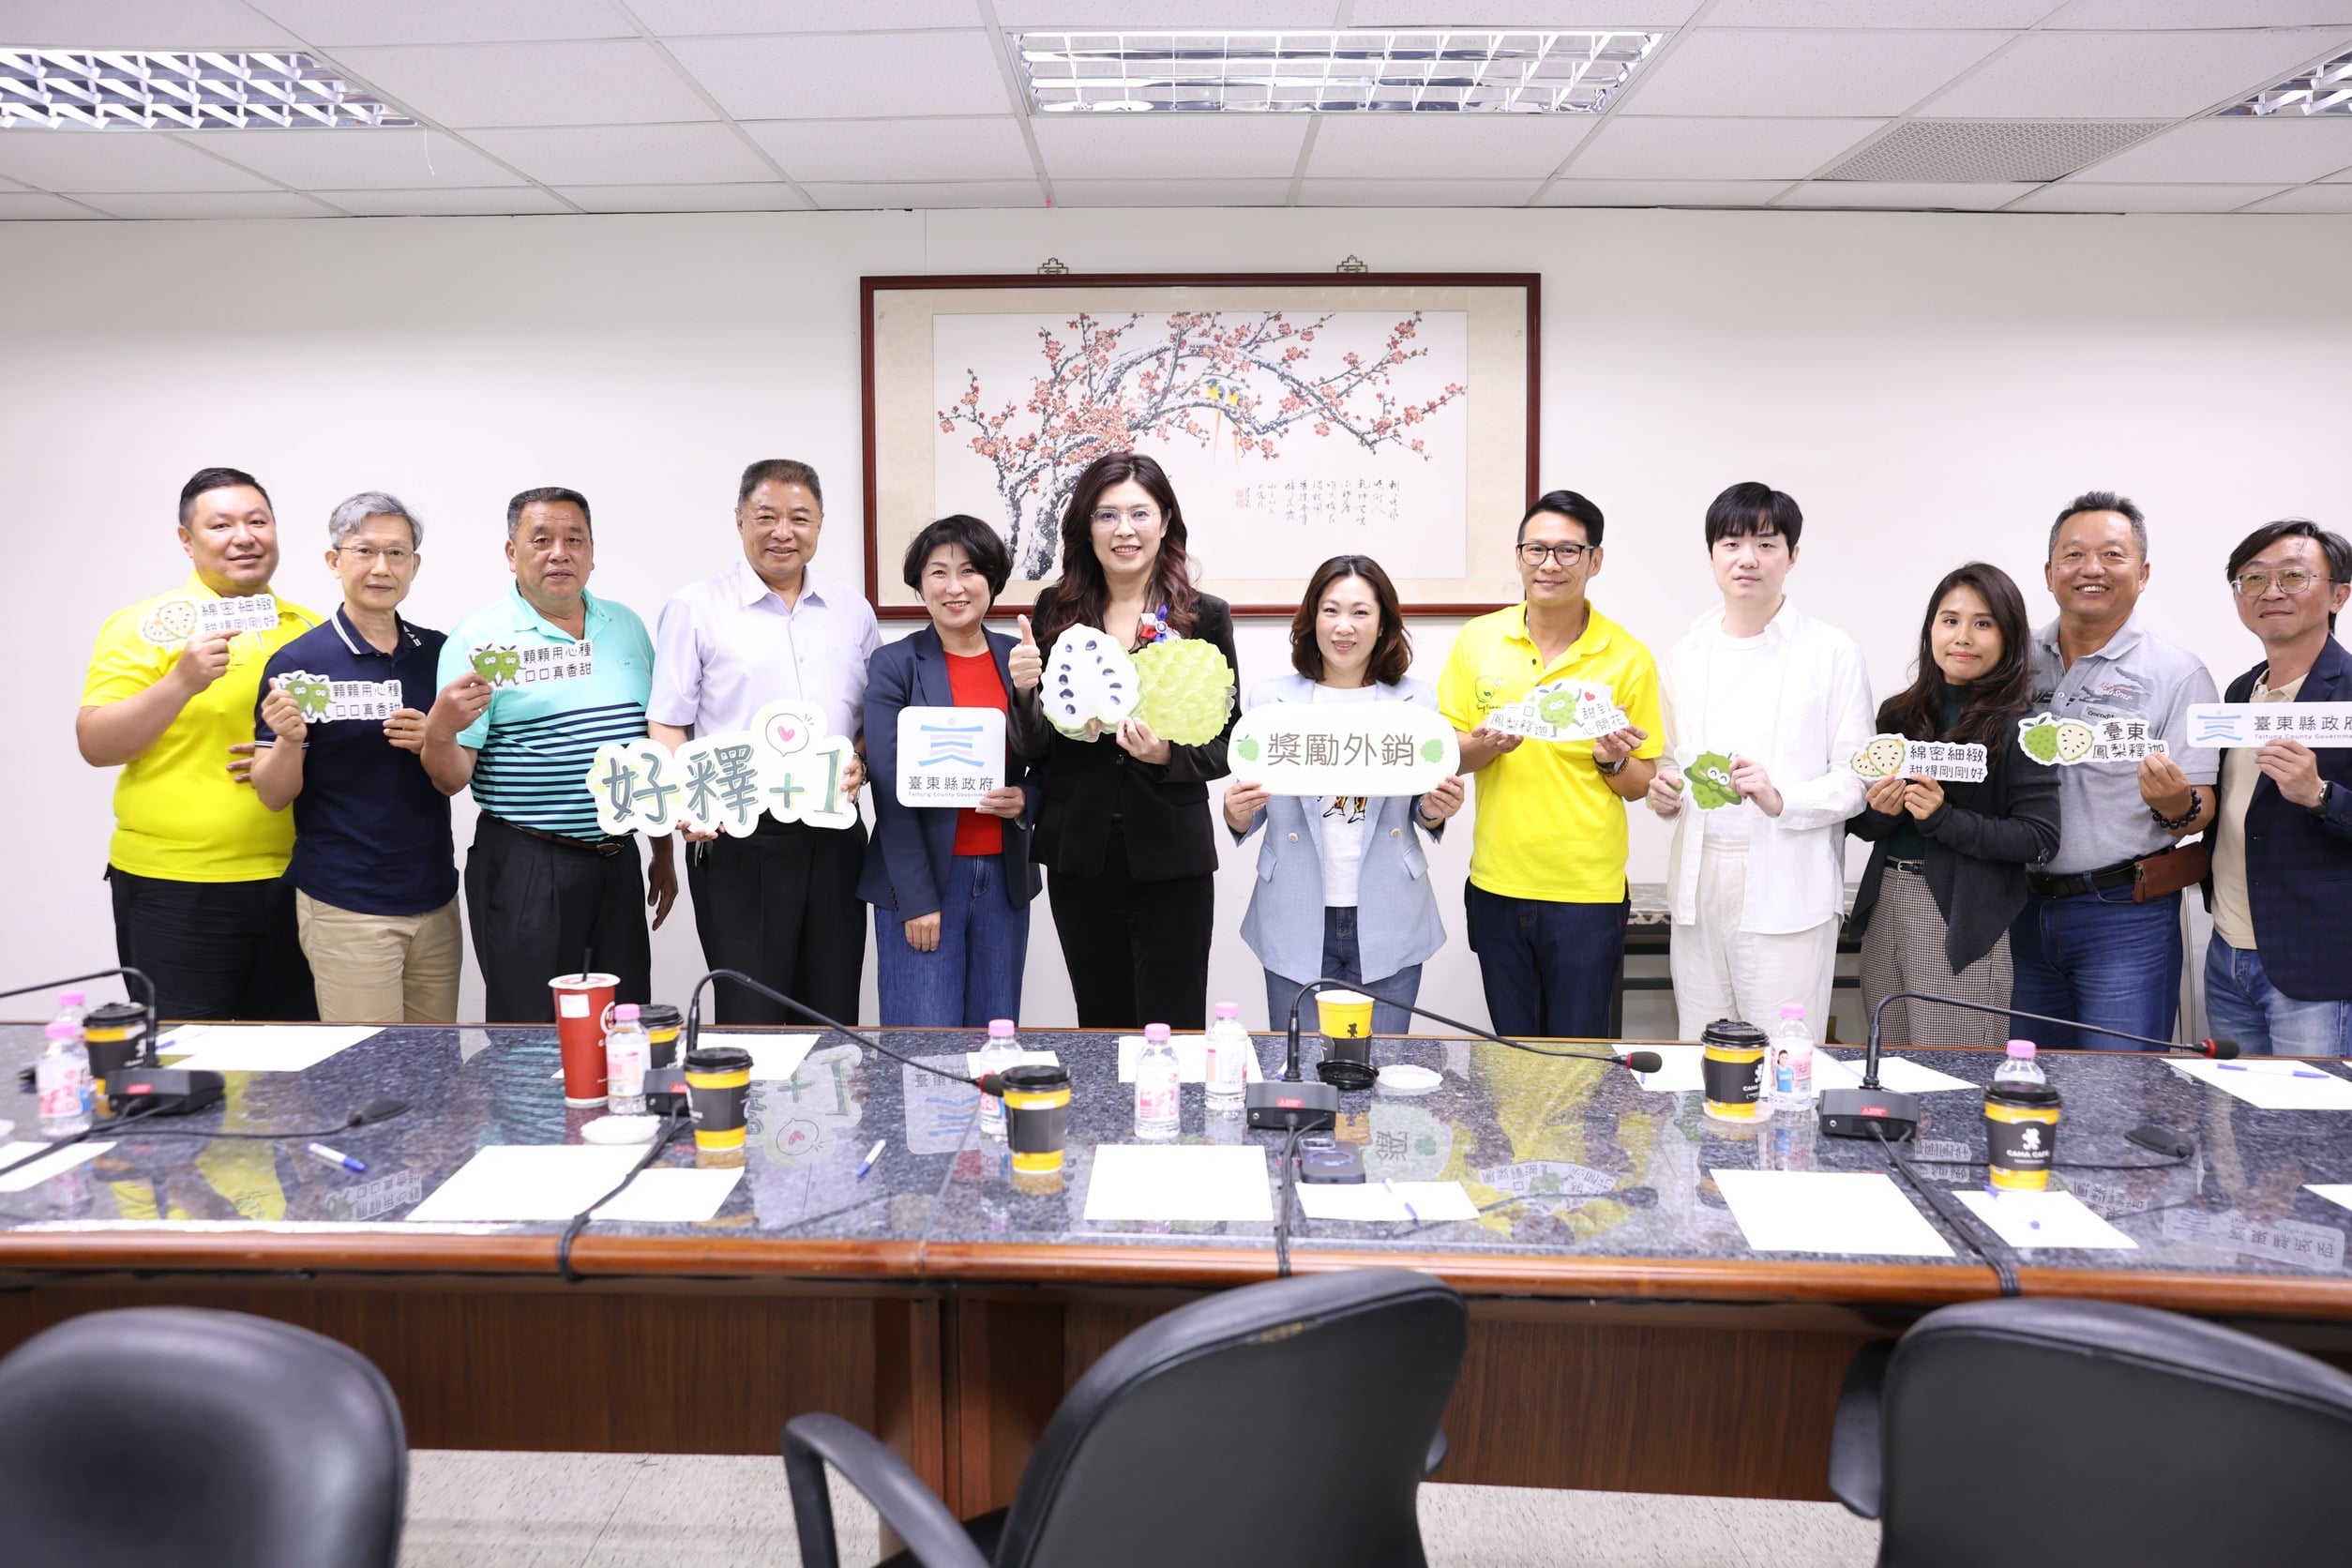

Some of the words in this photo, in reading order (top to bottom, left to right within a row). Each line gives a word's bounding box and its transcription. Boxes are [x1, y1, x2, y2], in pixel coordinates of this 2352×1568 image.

[523, 642, 591, 664] 顆顆用心種
[525, 661, 592, 682] 口口真香甜
[333, 683, 400, 698] 顆顆用心種
[2103, 721, 2146, 742] 臺東
[1267, 732, 1414, 766] 獎勵外銷
[1910, 745, 1984, 762] 綿密細緻
[909, 776, 994, 791] 臺東縣政府
